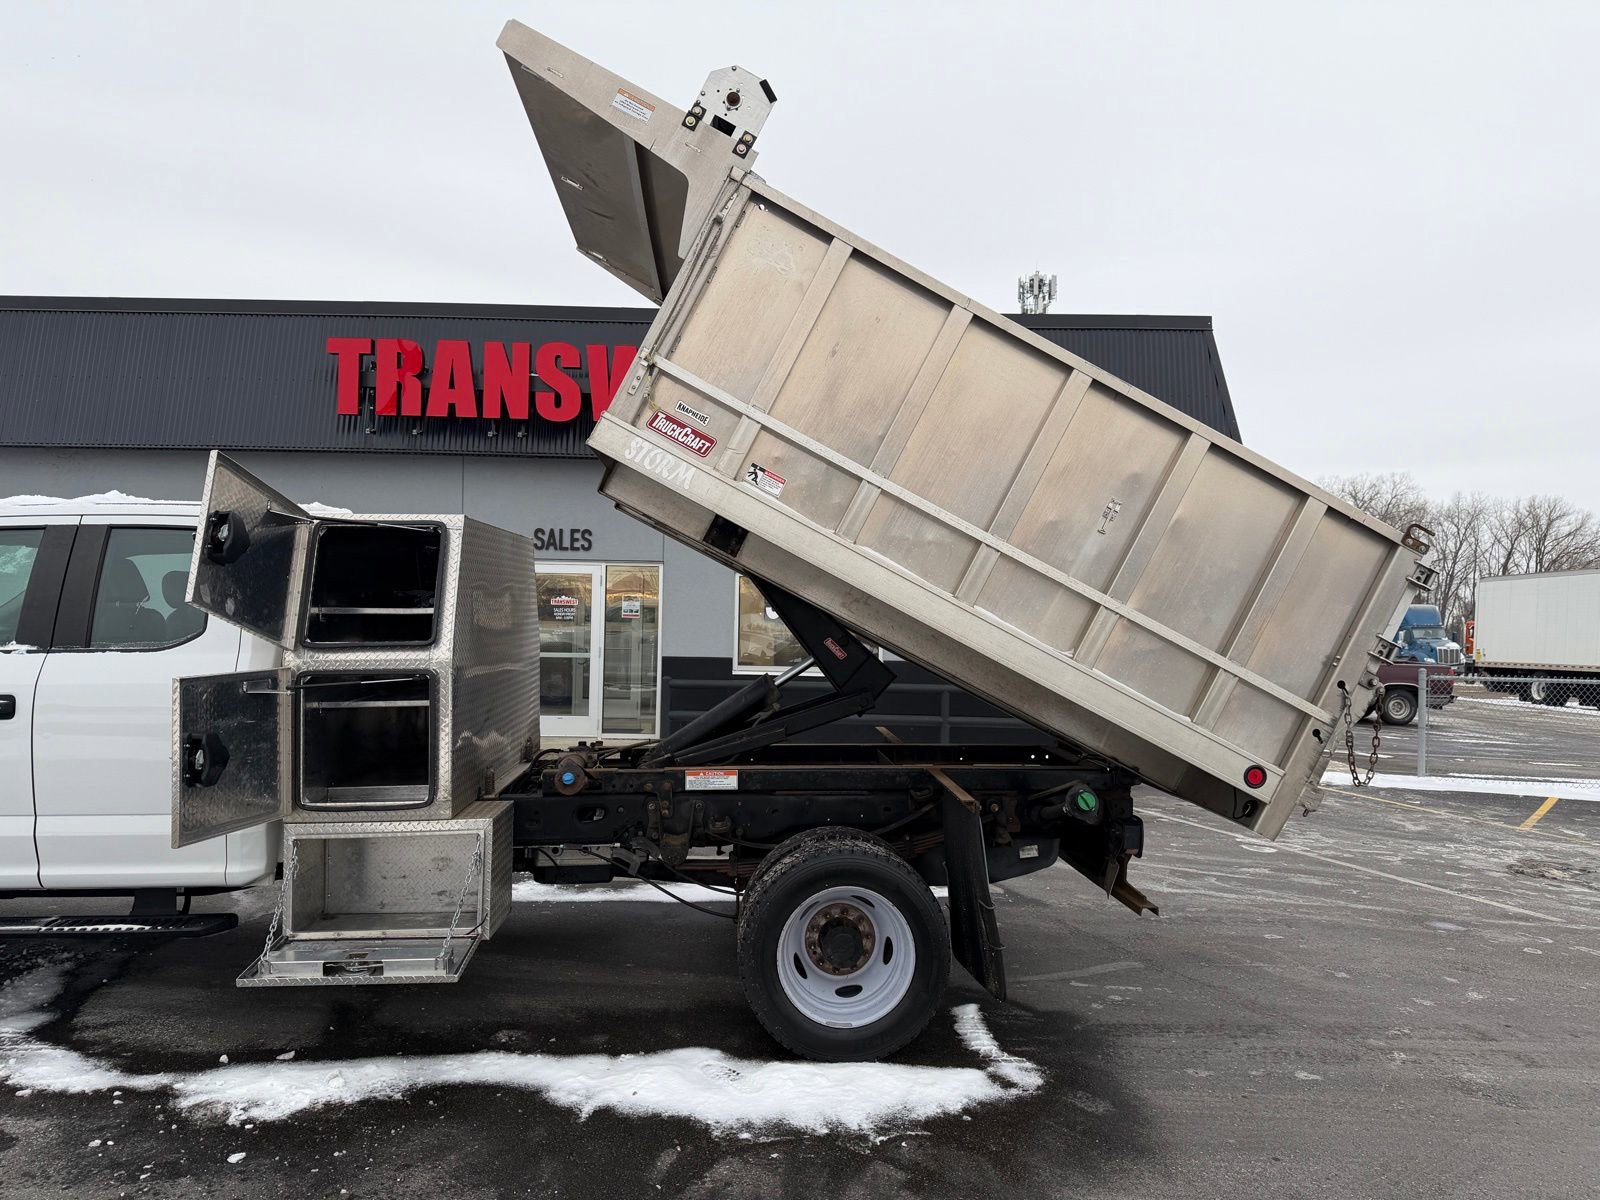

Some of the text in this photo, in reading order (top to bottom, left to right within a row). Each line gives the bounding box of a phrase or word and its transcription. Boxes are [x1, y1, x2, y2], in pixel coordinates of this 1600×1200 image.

[676, 402, 709, 425] KNAPHEIDE
[624, 438, 697, 490] STORM
[534, 528, 592, 551] SALES
